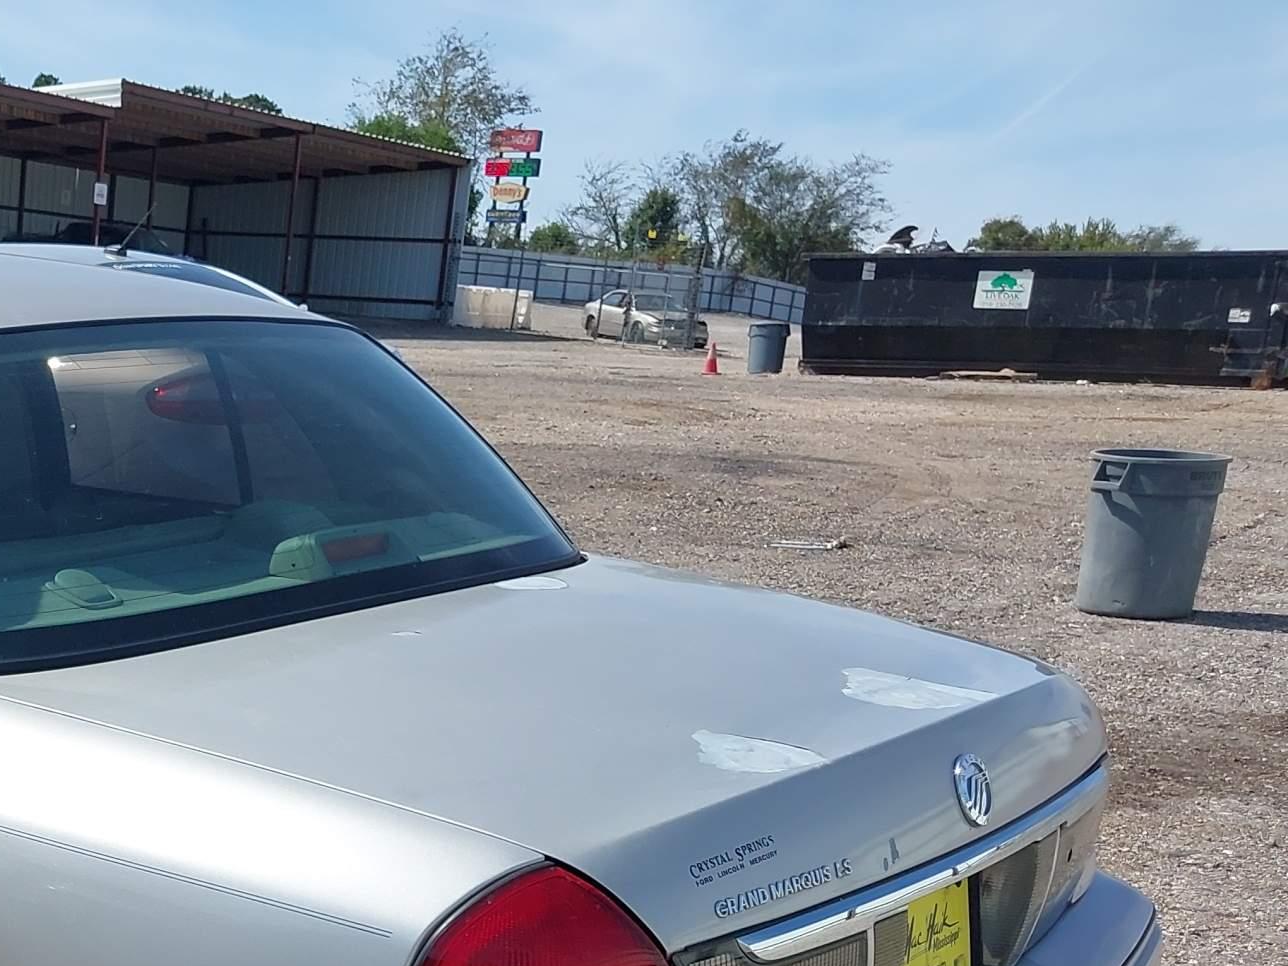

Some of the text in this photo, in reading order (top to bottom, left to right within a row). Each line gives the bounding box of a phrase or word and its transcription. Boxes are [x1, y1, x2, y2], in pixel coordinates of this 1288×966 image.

[493, 185, 523, 198] Denny's
[689, 835, 775, 880] CRYSTAL SPRINGS
[695, 850, 778, 888] FORD LINCOLN MERCURY
[714, 858, 853, 918] GRAND MARQUIS LS
[932, 927, 961, 952] Mississippi
